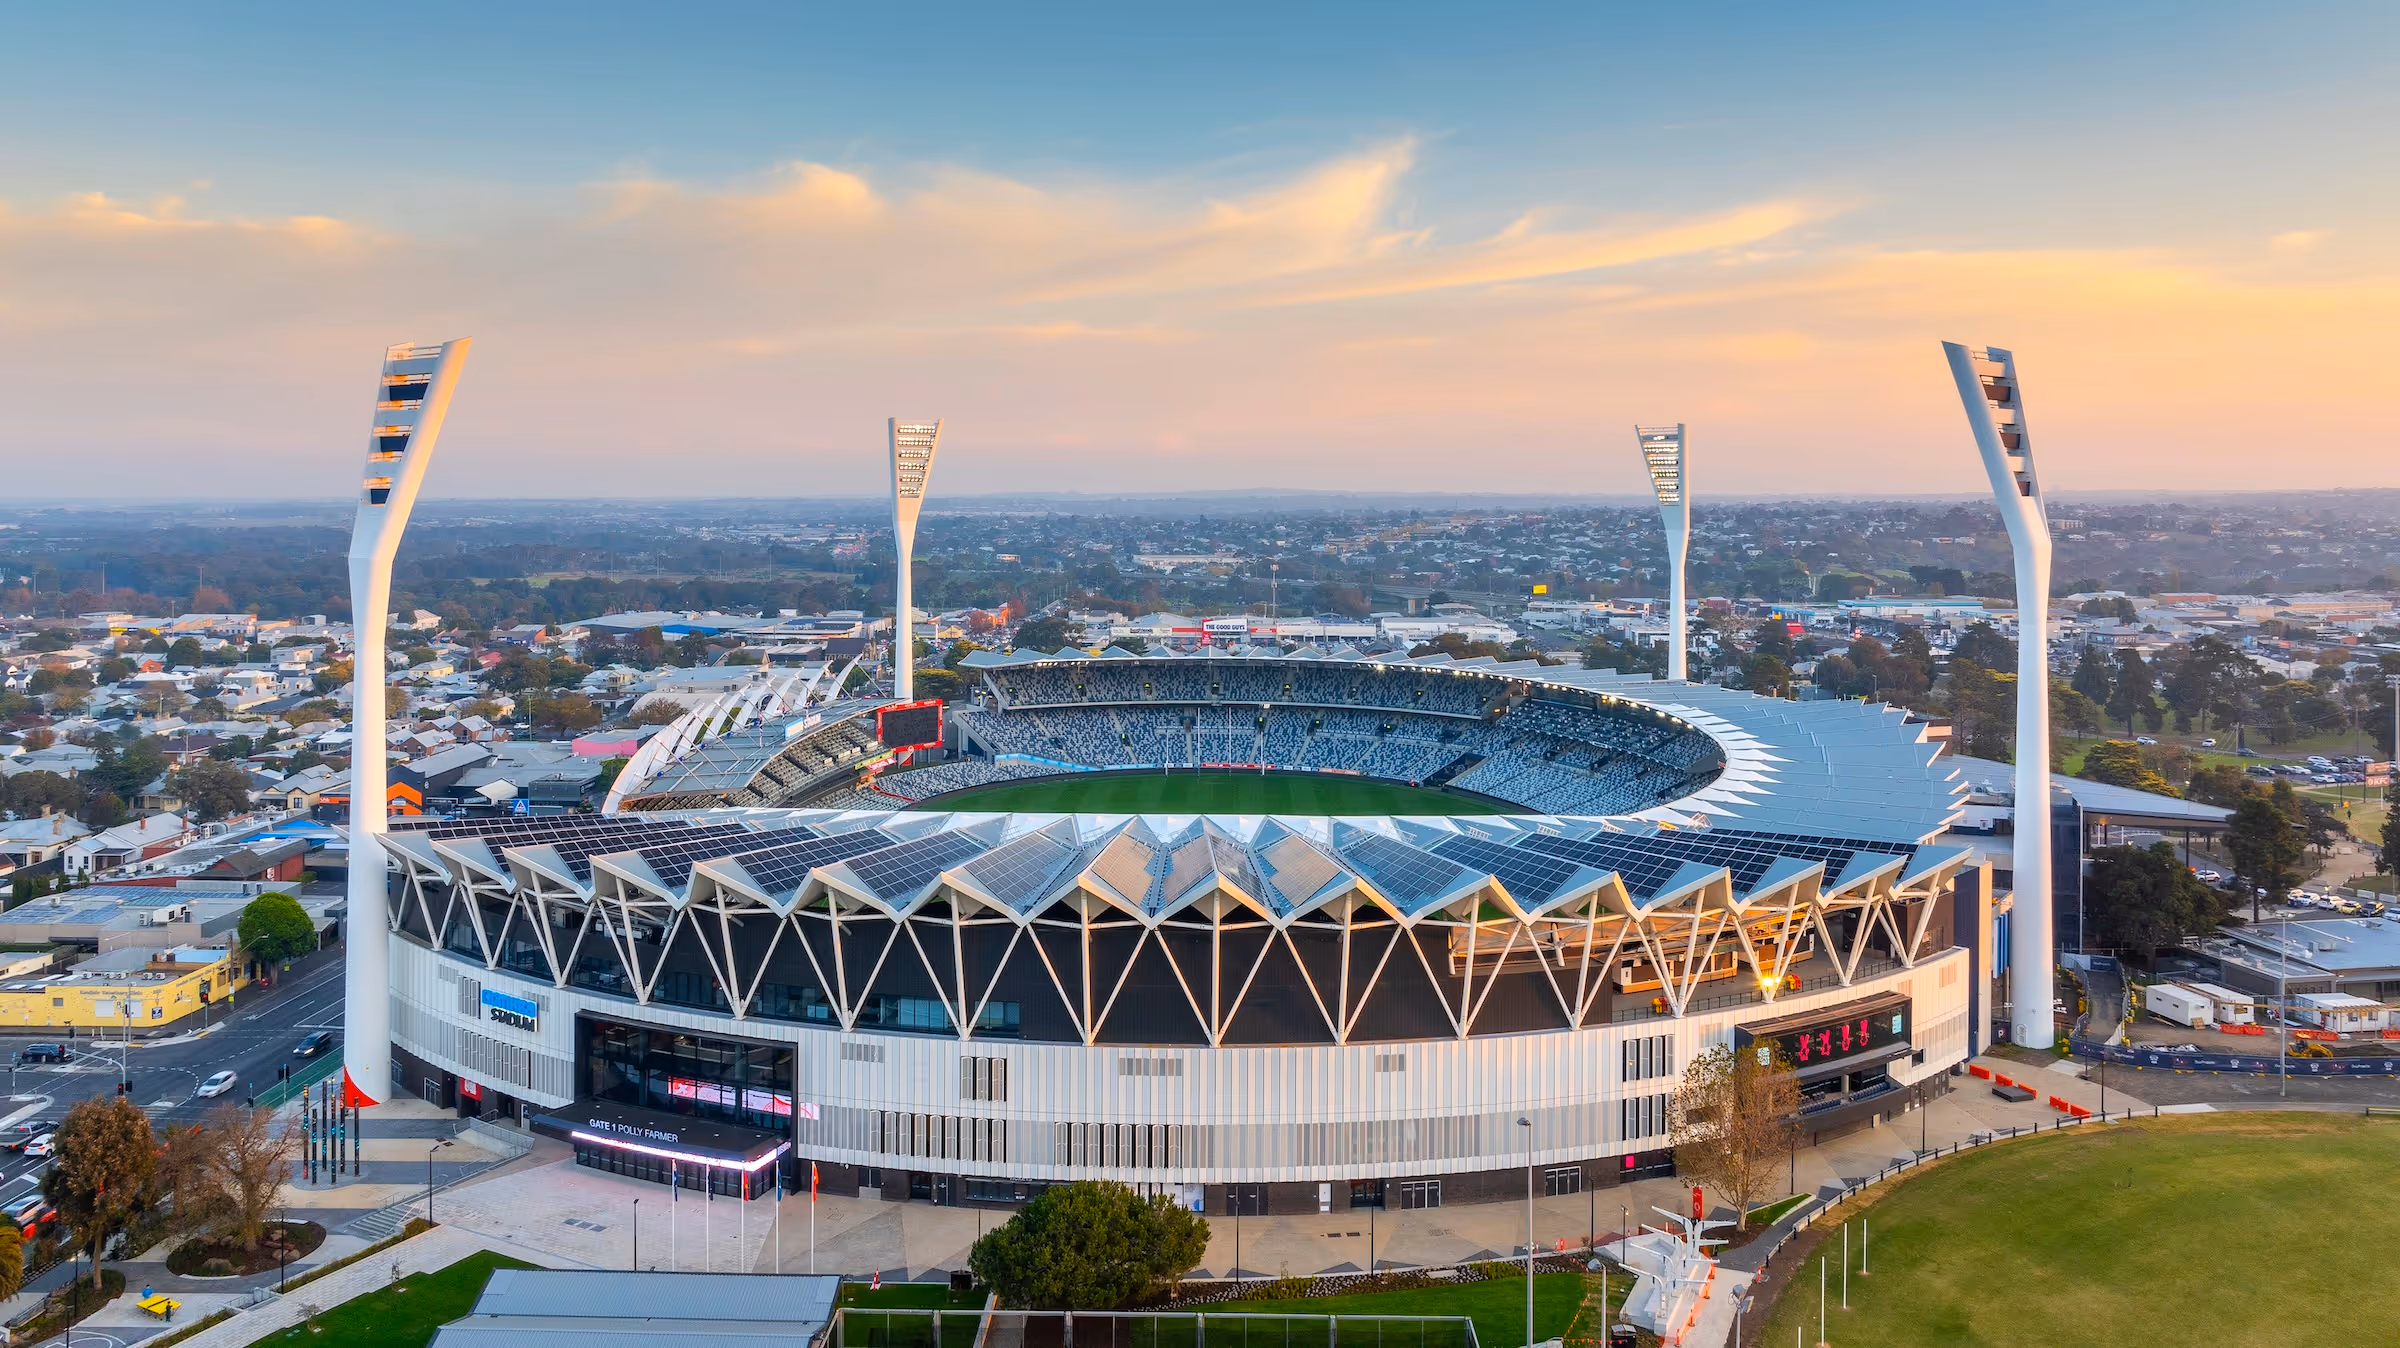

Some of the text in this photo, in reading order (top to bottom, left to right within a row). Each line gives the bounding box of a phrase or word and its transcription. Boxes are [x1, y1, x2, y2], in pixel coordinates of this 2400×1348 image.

[2374, 777, 2388, 786] KFC
[490, 1008, 535, 1032] STADIUM
[589, 1119, 679, 1143] GATE 1 POLLY FARMER
